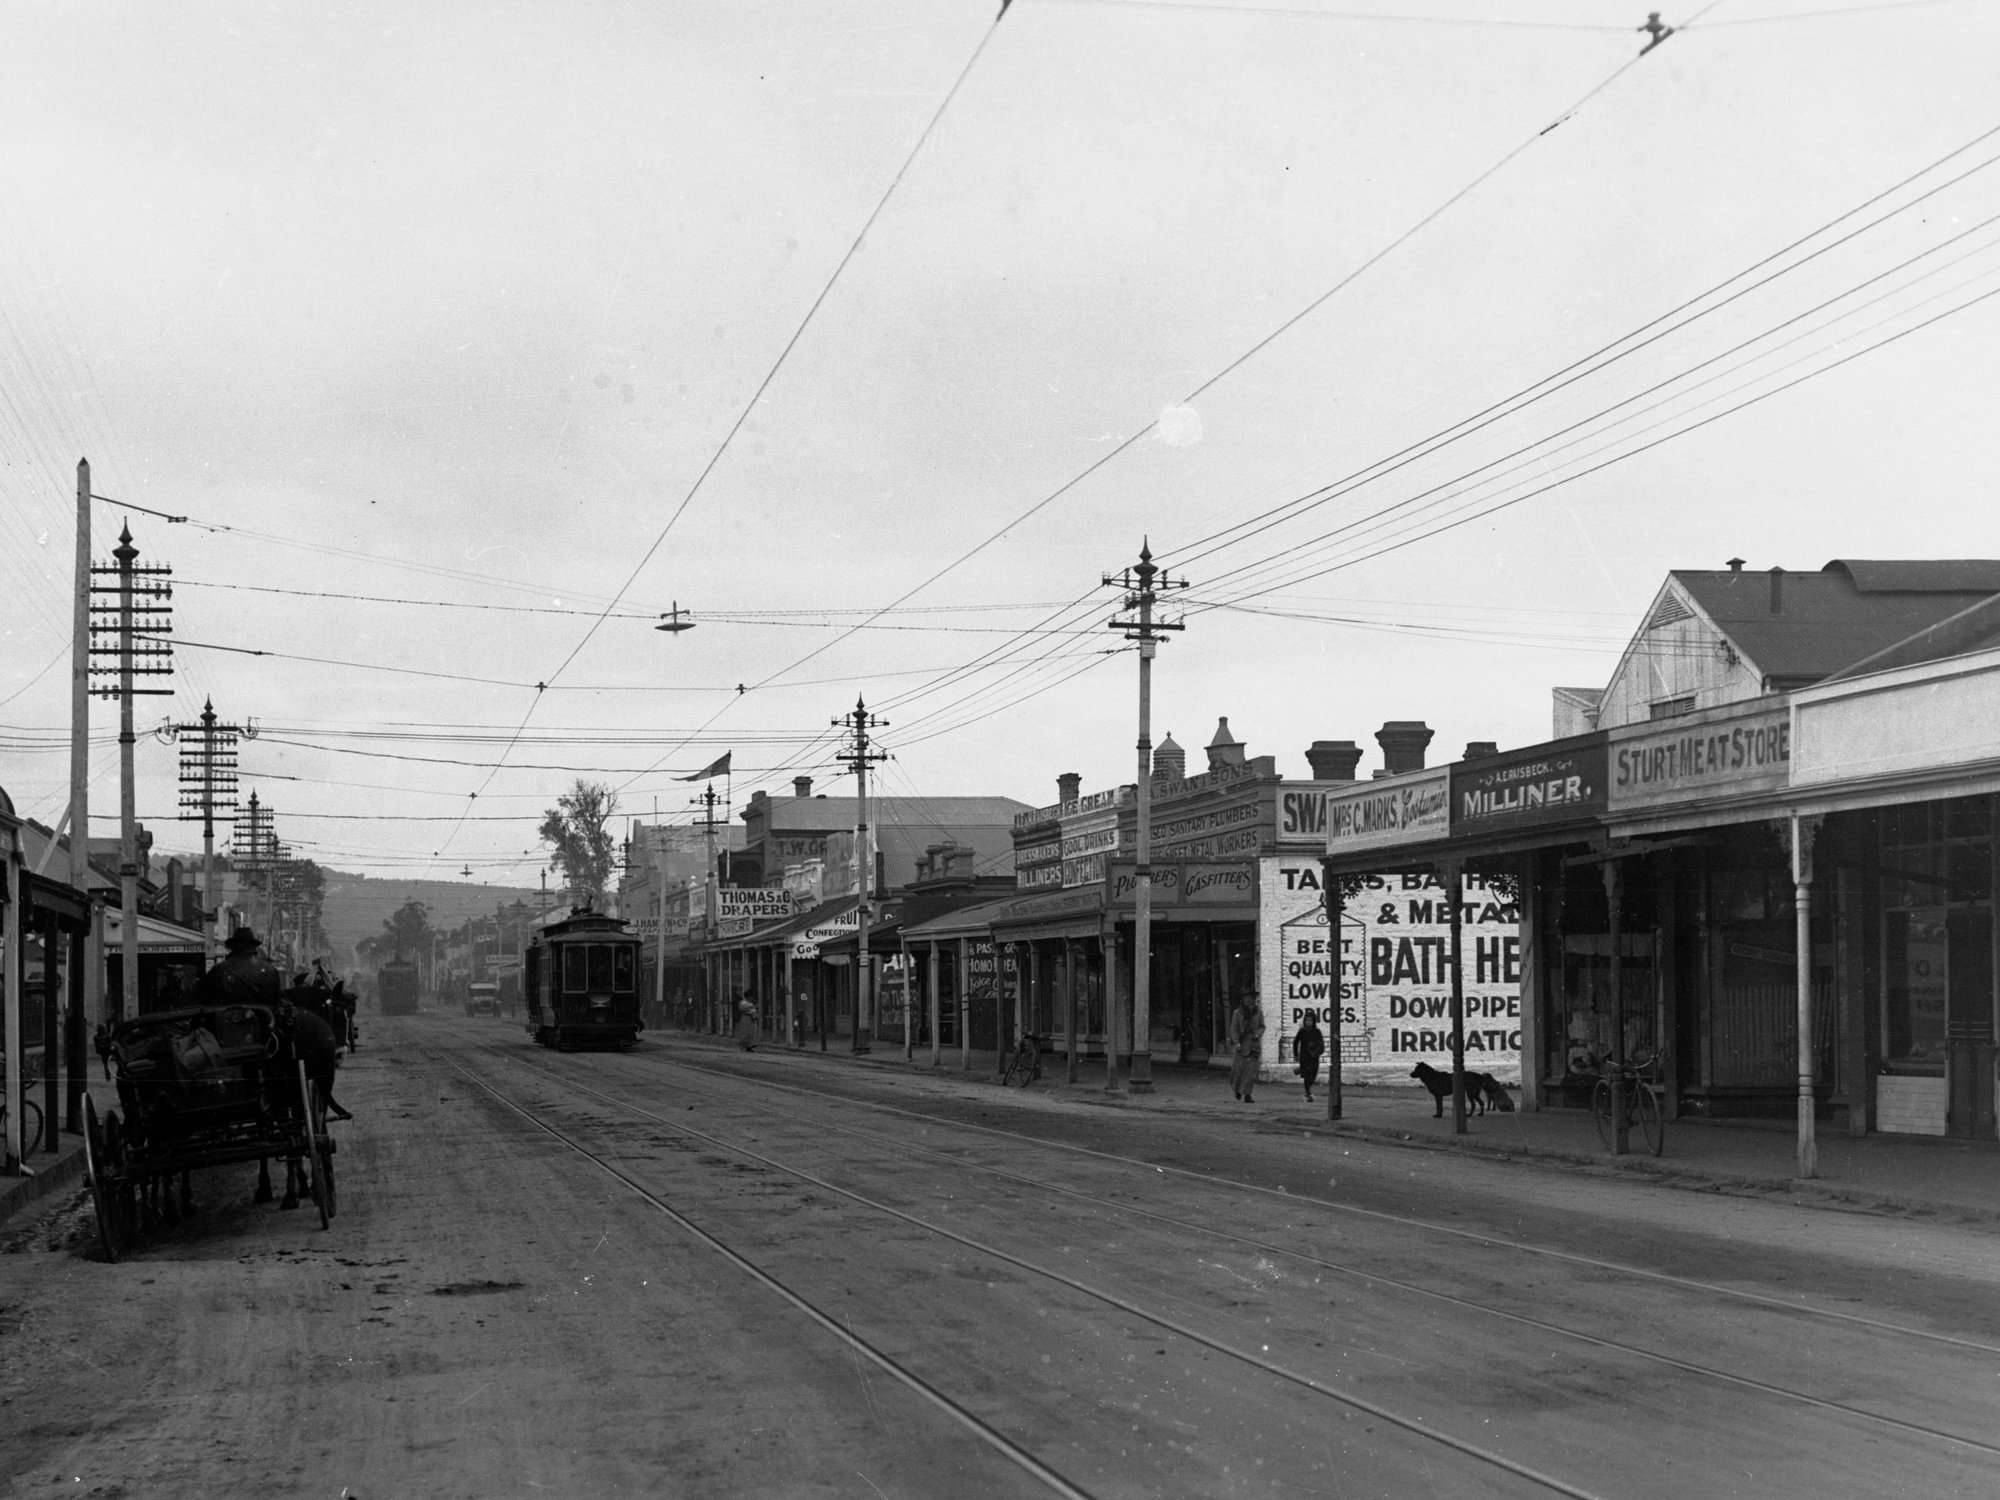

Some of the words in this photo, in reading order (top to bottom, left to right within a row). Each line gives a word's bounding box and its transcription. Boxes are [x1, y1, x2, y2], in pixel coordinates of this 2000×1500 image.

[1617, 744, 1676, 786] STURT
[1679, 734, 1730, 776] MEAT
[1731, 722, 1790, 768] STORE
[1463, 776, 1592, 820] MILLINER.
[1170, 818, 1206, 838] SANITARY
[1210, 804, 1259, 829] PLUMBERS
[1284, 793, 1327, 833] SWA
[1063, 837, 1084, 857] COOL
[1085, 830, 1114, 851] DRINKS
[1217, 831, 1257, 855] WORKERS
[1113, 869, 1179, 898] PLUBERS
[1186, 871, 1253, 897] GASFITTERS
[719, 890, 775, 904] THOMAS
[721, 904, 789, 917] DRAPERS
[835, 910, 858, 925] FRUI
[1377, 903, 1400, 925] &
[1288, 960, 1365, 980] QUALTY
[1475, 936, 1521, 985] HE
[1288, 983, 1364, 1001] LOWST
